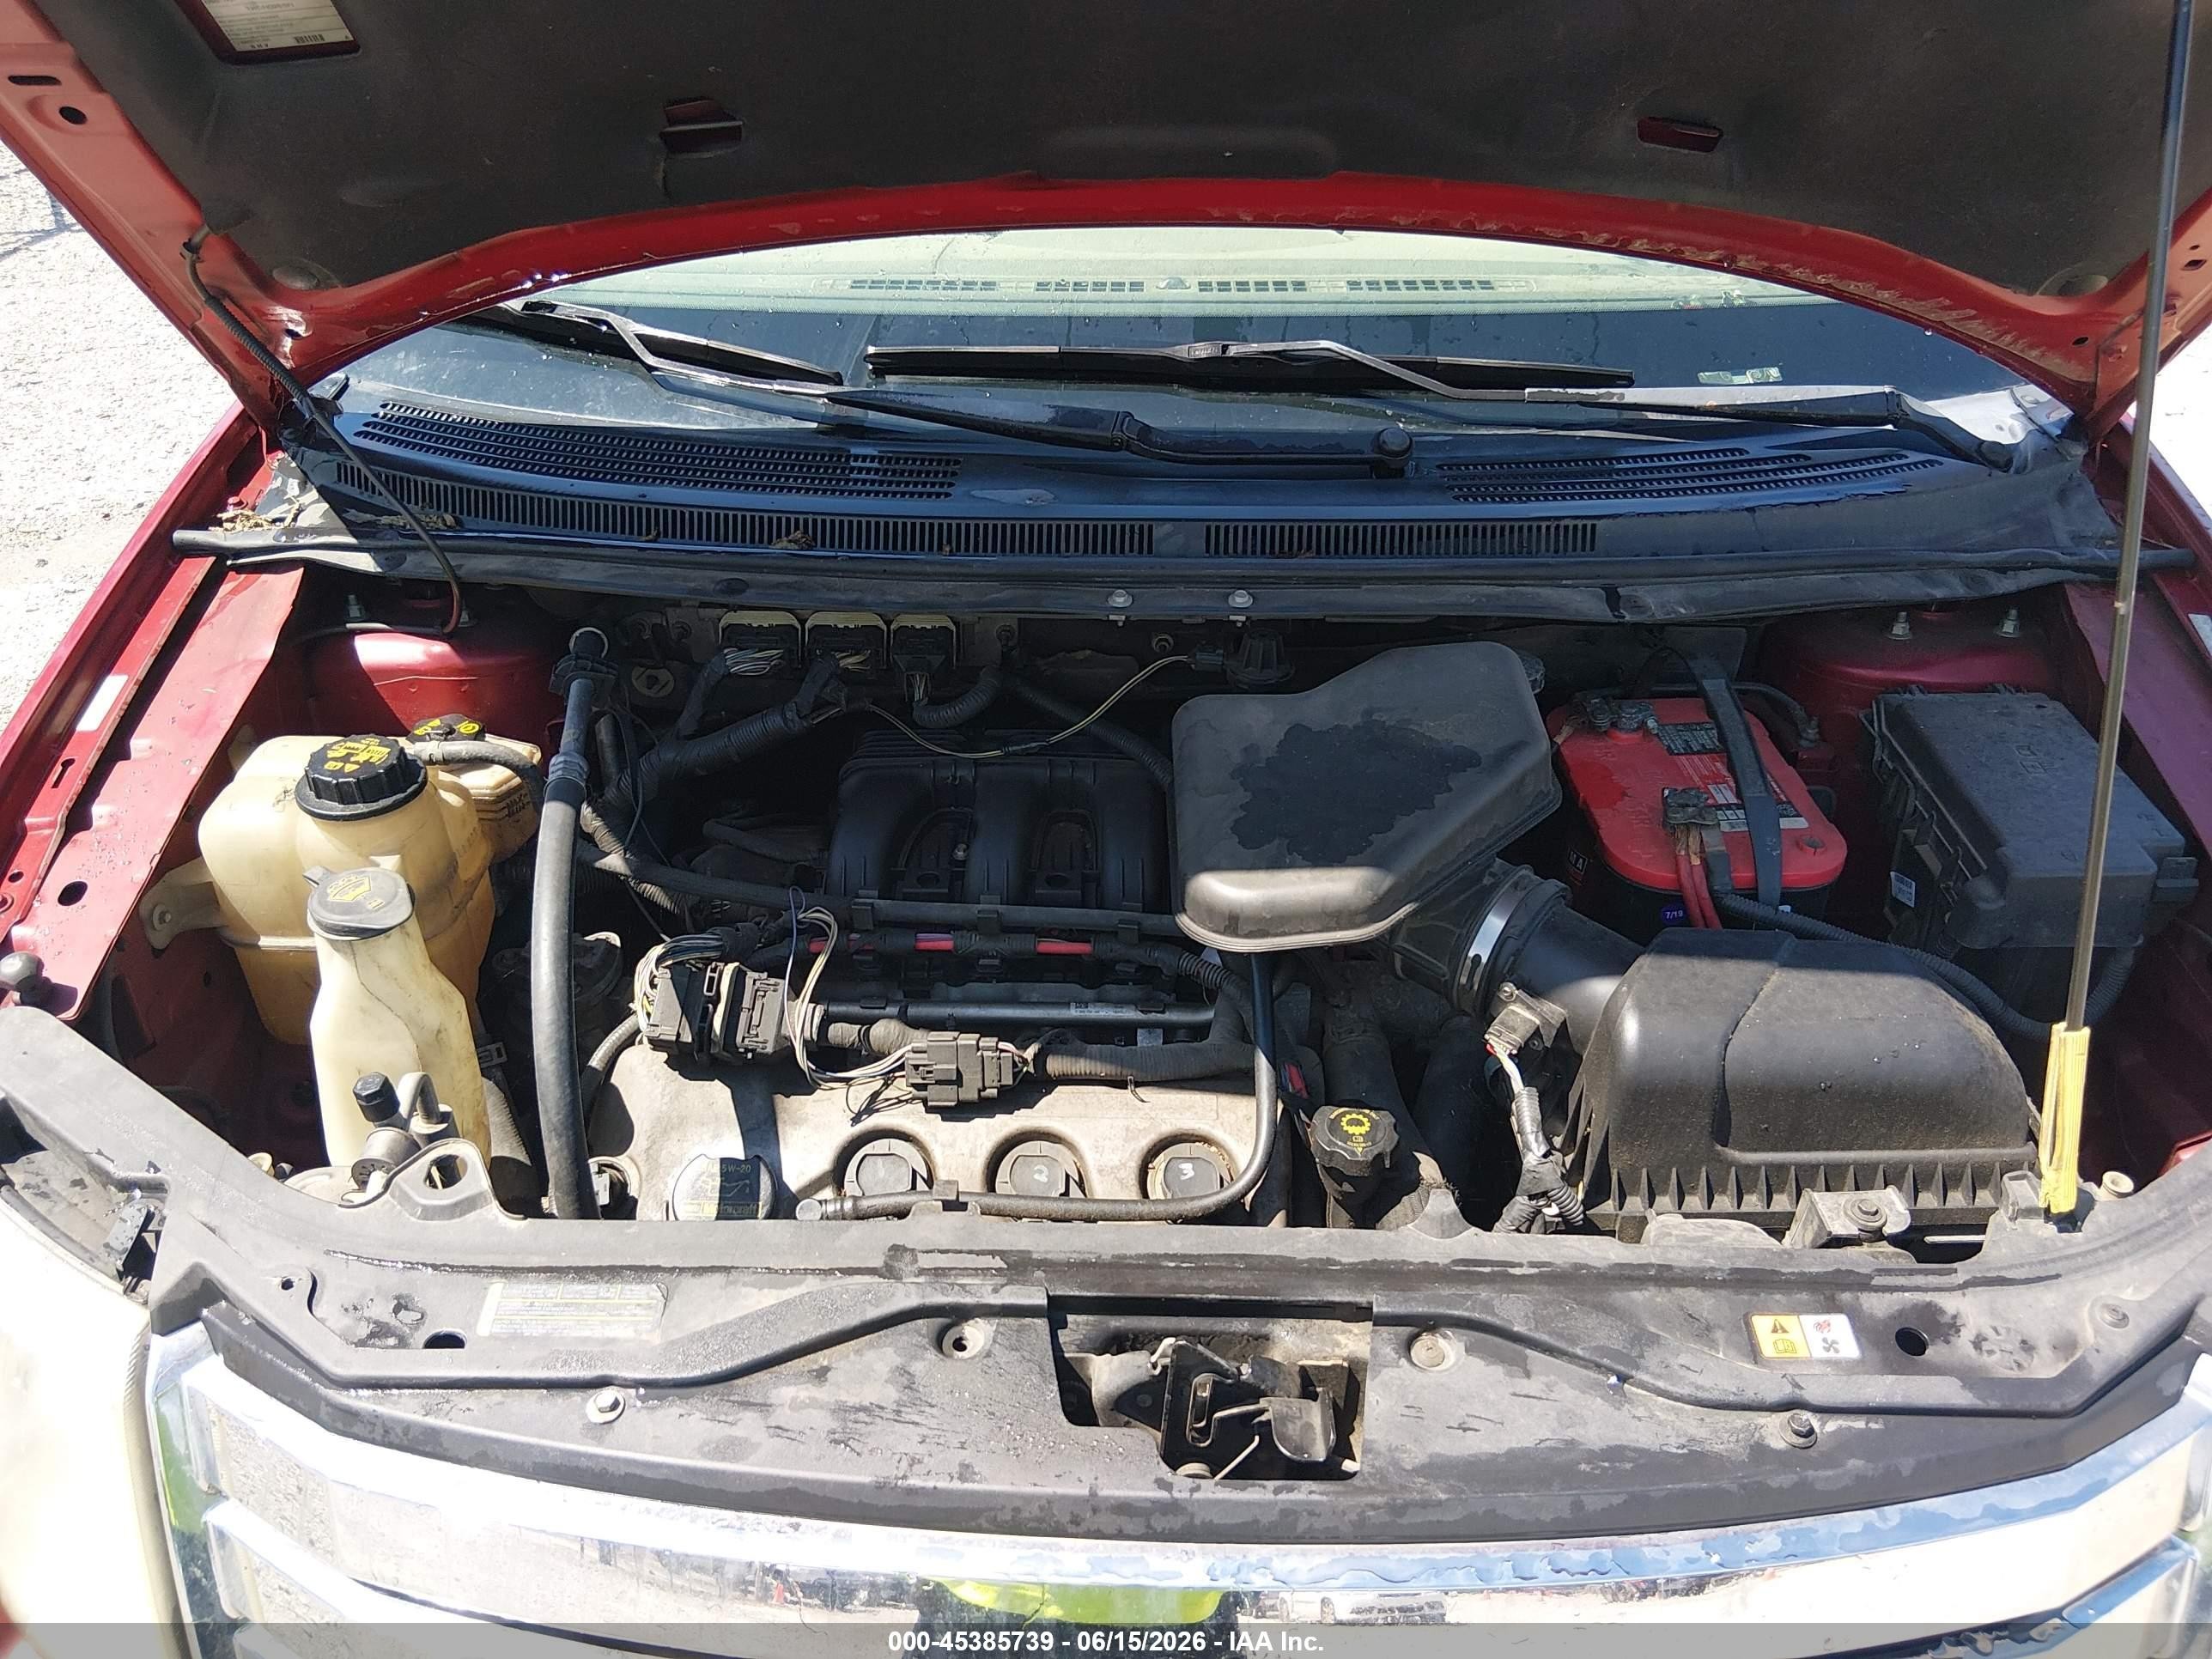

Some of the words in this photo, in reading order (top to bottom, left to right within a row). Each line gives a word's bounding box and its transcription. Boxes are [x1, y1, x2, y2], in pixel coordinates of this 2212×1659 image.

[1665, 910, 1683, 919] 7/19
[720, 1164, 751, 1173] 5W-20
[1033, 1164, 1049, 1182] 2
[1177, 1163, 1195, 1180] 3
